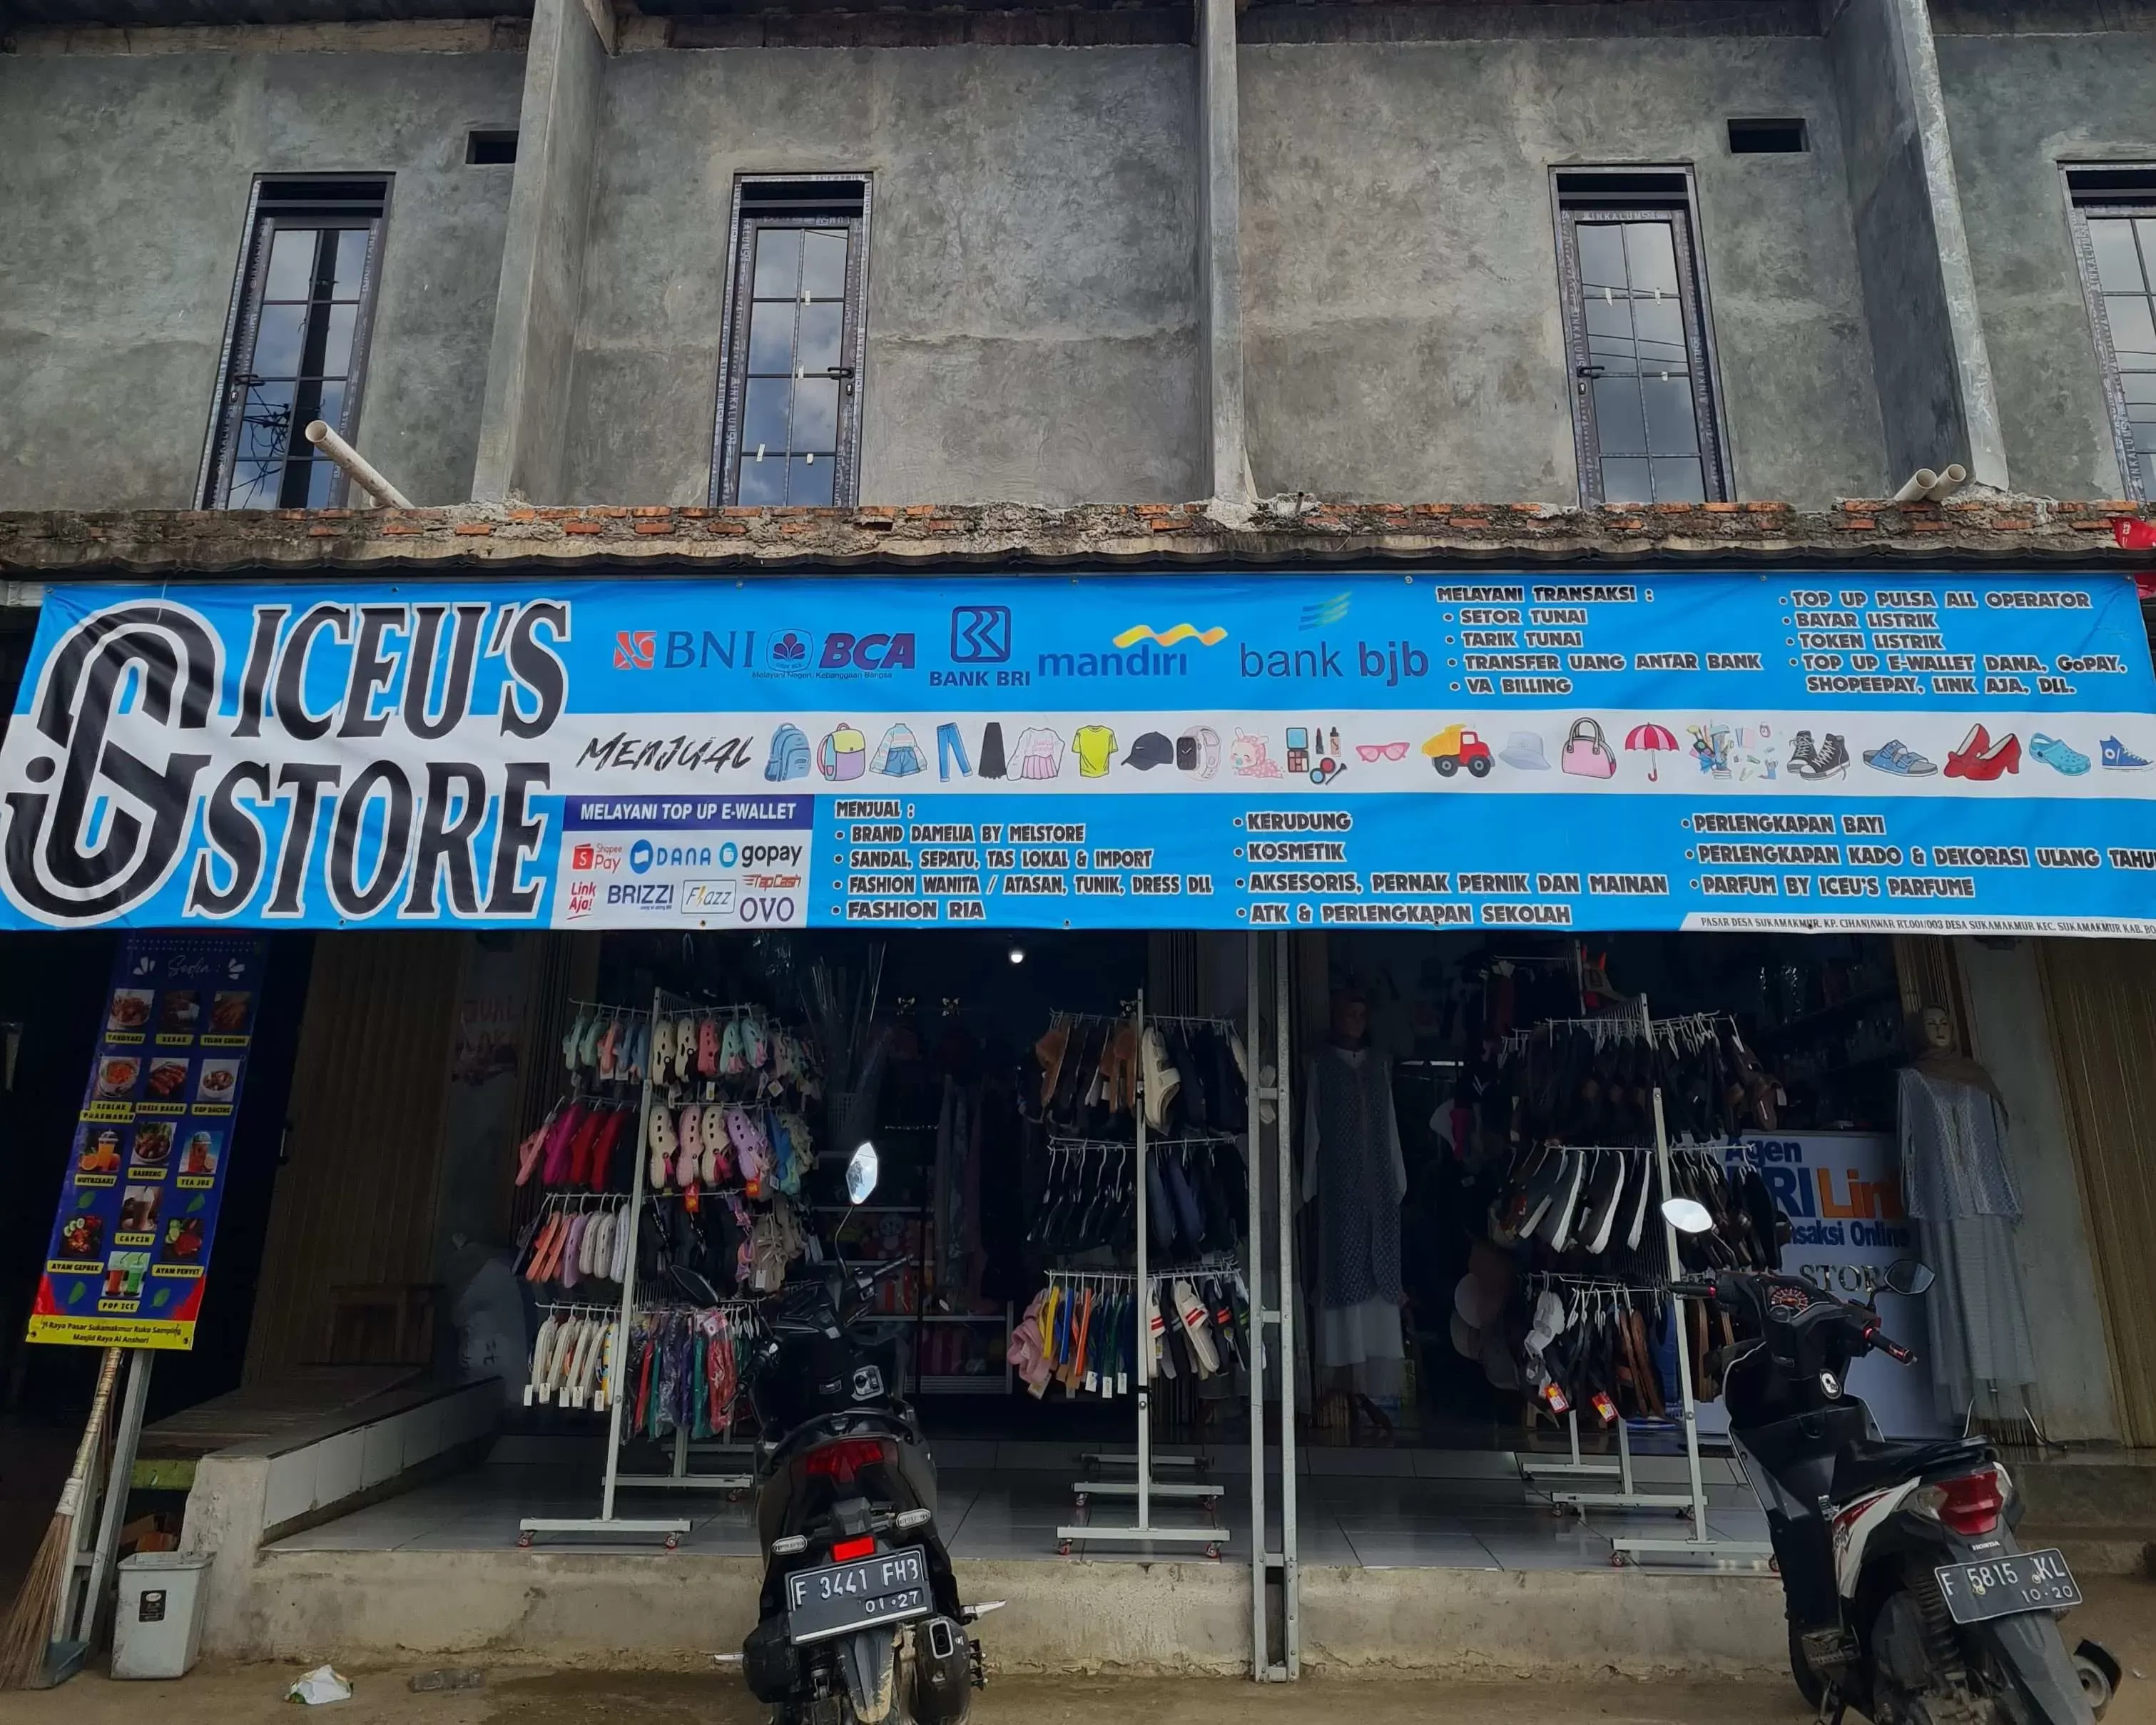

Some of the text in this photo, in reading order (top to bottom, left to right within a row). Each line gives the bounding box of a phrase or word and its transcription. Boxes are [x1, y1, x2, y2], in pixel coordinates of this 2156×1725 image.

[1438, 586, 1637, 602] MELAYANI TRANSAKSI
[1792, 591, 2092, 609] TOP UP PULSA ALL OPERATOR
[1460, 609, 1587, 625] SETOR TUNAI
[1796, 613, 1939, 629] BAYAR LISTRIK
[1463, 631, 1583, 647] TARIK TUNAI
[1801, 633, 1946, 650] TOKEN LISTRIK
[665, 631, 755, 668] BNI
[819, 633, 915, 669] BCA
[1039, 643, 1187, 676] mandiri
[1241, 641, 1428, 686] bank bjb
[1465, 653, 1763, 671] TRANSFER UANG ANTAR BANK
[1801, 655, 1843, 671] TOP
[1852, 655, 1878, 671] UP
[1888, 655, 1975, 671] E-WALLET
[232, 601, 569, 741] ICEU'S
[930, 671, 1030, 686] BANK BRI
[1465, 678, 1572, 693] VA BILLING
[1933, 677, 1979, 694] LINK
[581, 803, 796, 820] MELAYANI TOP UP E-WALLET
[835, 800, 900, 818] MENJUAL
[1247, 813, 1352, 831] KERUDUNG
[1694, 813, 1886, 835] PERLENGKAPAN BAYI
[186, 759, 551, 917] STORE
[851, 824, 1085, 843] BRAND DAMELIA BY MELSTORE
[596, 843, 622, 854] Shopee
[656, 848, 711, 865] DANA
[741, 845, 803, 867] gopay
[1248, 843, 1346, 862] KOSMETIK
[1698, 845, 2156, 870] PERLENGKAPAN KADO & DEKORASI ULANG TAHU
[594, 854, 622, 873] Pay
[850, 850, 1154, 869] SANDAL, SEPATU, TAS LOKAL & IMPORT
[571, 881, 596, 897] Link
[848, 875, 915, 894] FASHION
[922, 876, 979, 894] WANITA
[1003, 875, 1067, 895] ATASAN,
[1074, 875, 1124, 895] TUNIK,
[1132, 876, 1181, 894] DRESS
[1188, 876, 1214, 894] DLL
[1249, 873, 1669, 895] AKSESORIS, PERNAK PERNIK DAN MAINAN
[1702, 876, 1975, 898] PARFUM BY ICEU'S PARFUME
[569, 897, 594, 912] Aja!
[607, 885, 674, 905] BRIZZI
[740, 897, 795, 922] OVO
[847, 901, 985, 920] FASHION RIA
[1251, 904, 1572, 925] ATK & PERLENGKAPAN SEKOLAH
[1701, 917, 1728, 926] PASAR
[1732, 917, 1751, 927] DESA
[1946, 920, 1969, 930] DESA
[1969, 920, 2035, 931] SUKAMAKMUR
[2058, 922, 2121, 932] SUKAMAKMUR
[1800, 1264, 1888, 1292] STOR
[49, 1322, 66, 1330] Raya
[1971, 1540, 2000, 1551] HONDA
[795, 1569, 868, 1605] F 3441
[1941, 1563, 2018, 1596] F 5815
